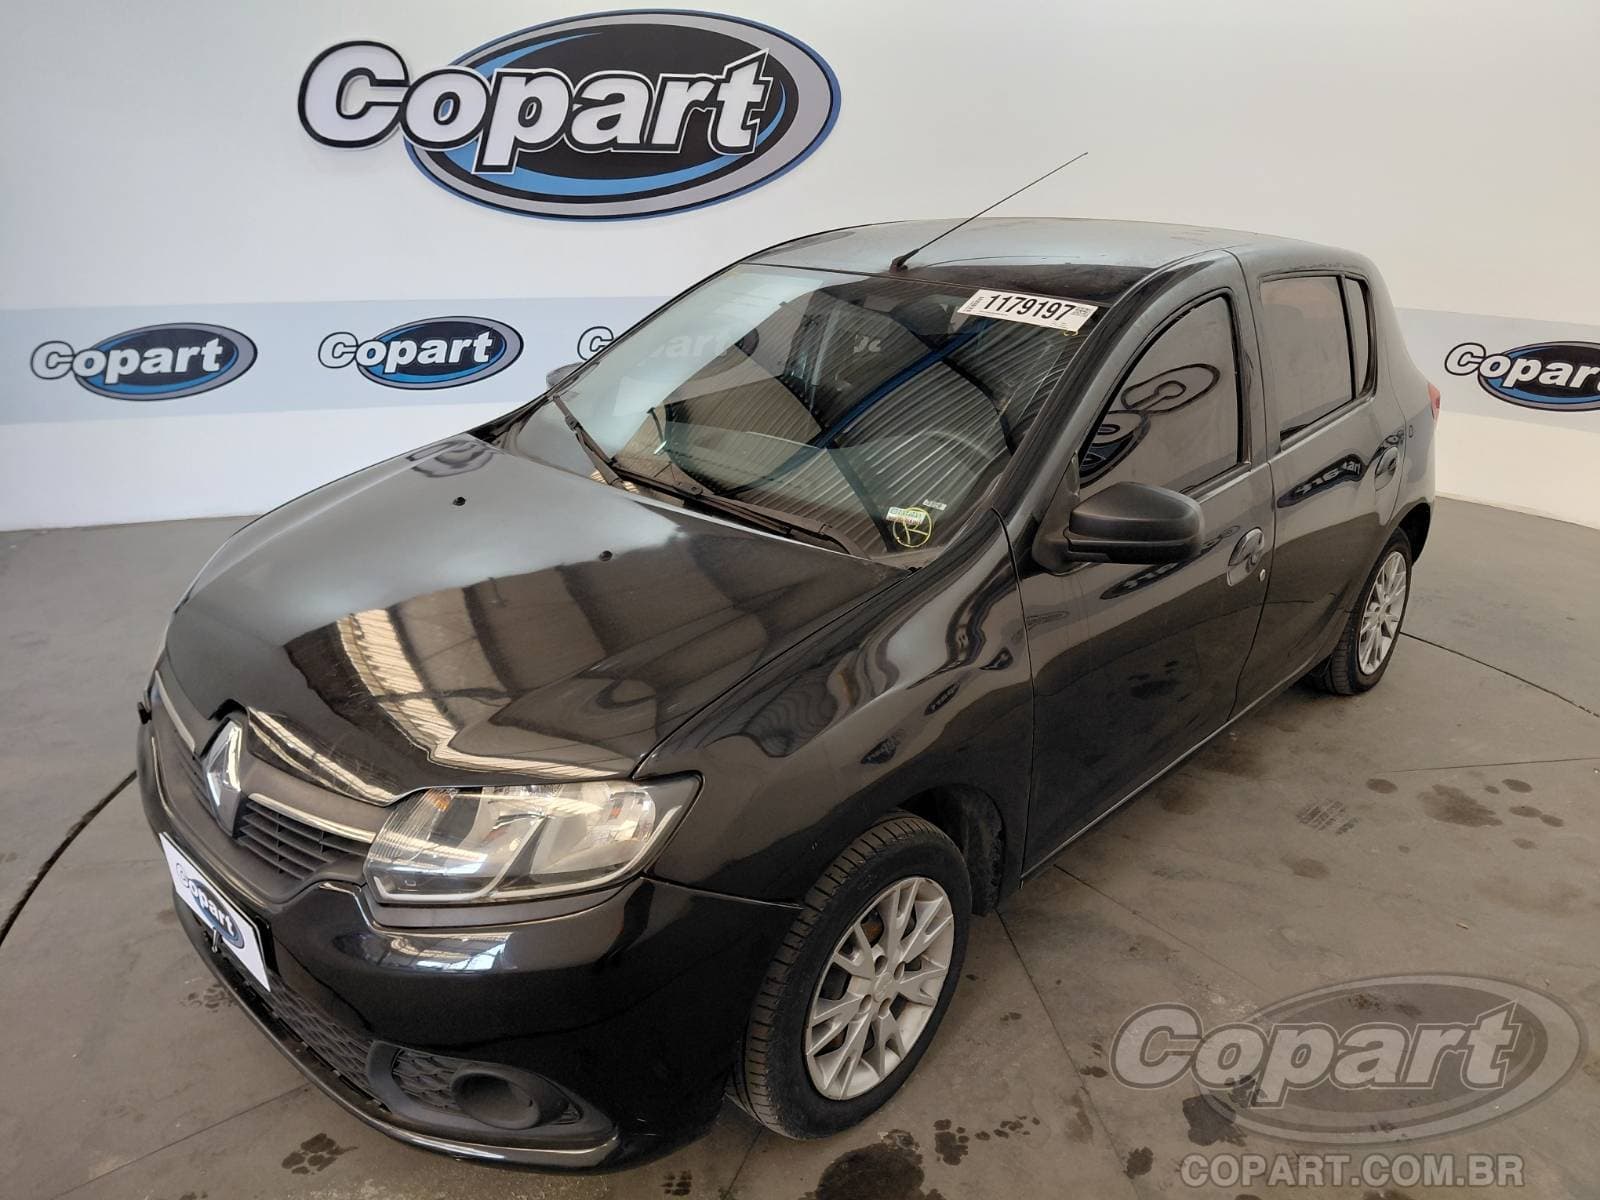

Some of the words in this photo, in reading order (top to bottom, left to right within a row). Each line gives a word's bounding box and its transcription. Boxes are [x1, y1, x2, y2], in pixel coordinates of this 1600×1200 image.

[299, 41, 773, 173] Copart
[984, 294, 1076, 321] 1179197
[30, 337, 224, 385] Copart
[318, 329, 494, 374] Copart
[1445, 342, 1600, 392] Copar
[175, 862, 236, 937] Copart
